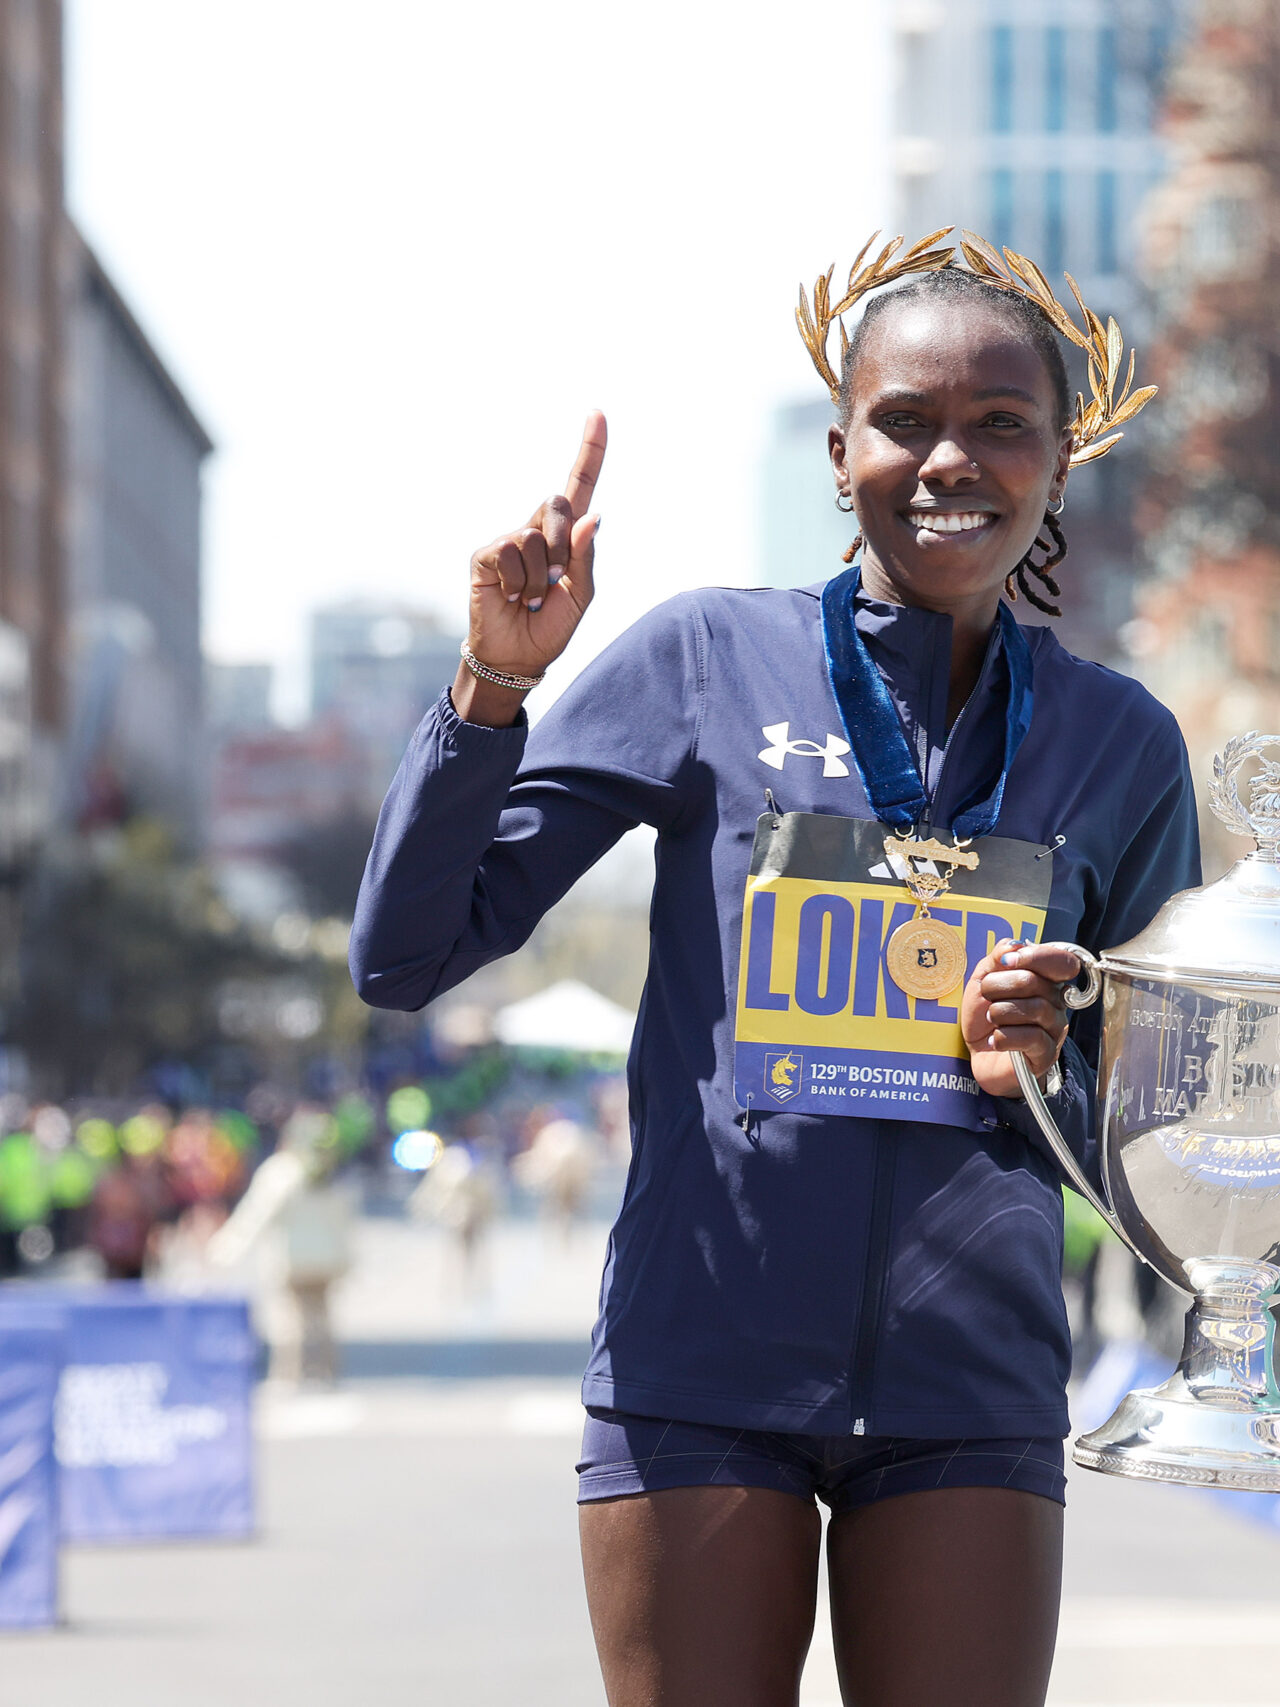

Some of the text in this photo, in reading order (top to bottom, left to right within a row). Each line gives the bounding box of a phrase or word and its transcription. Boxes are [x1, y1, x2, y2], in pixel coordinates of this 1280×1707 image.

[745, 891, 1038, 1024] LOK
[1130, 1009, 1184, 1031] BOSTON
[810, 1063, 847, 1080] 129TH
[848, 1066, 918, 1086] BOSTON
[810, 1085, 930, 1103] BANK OF AMERICA
